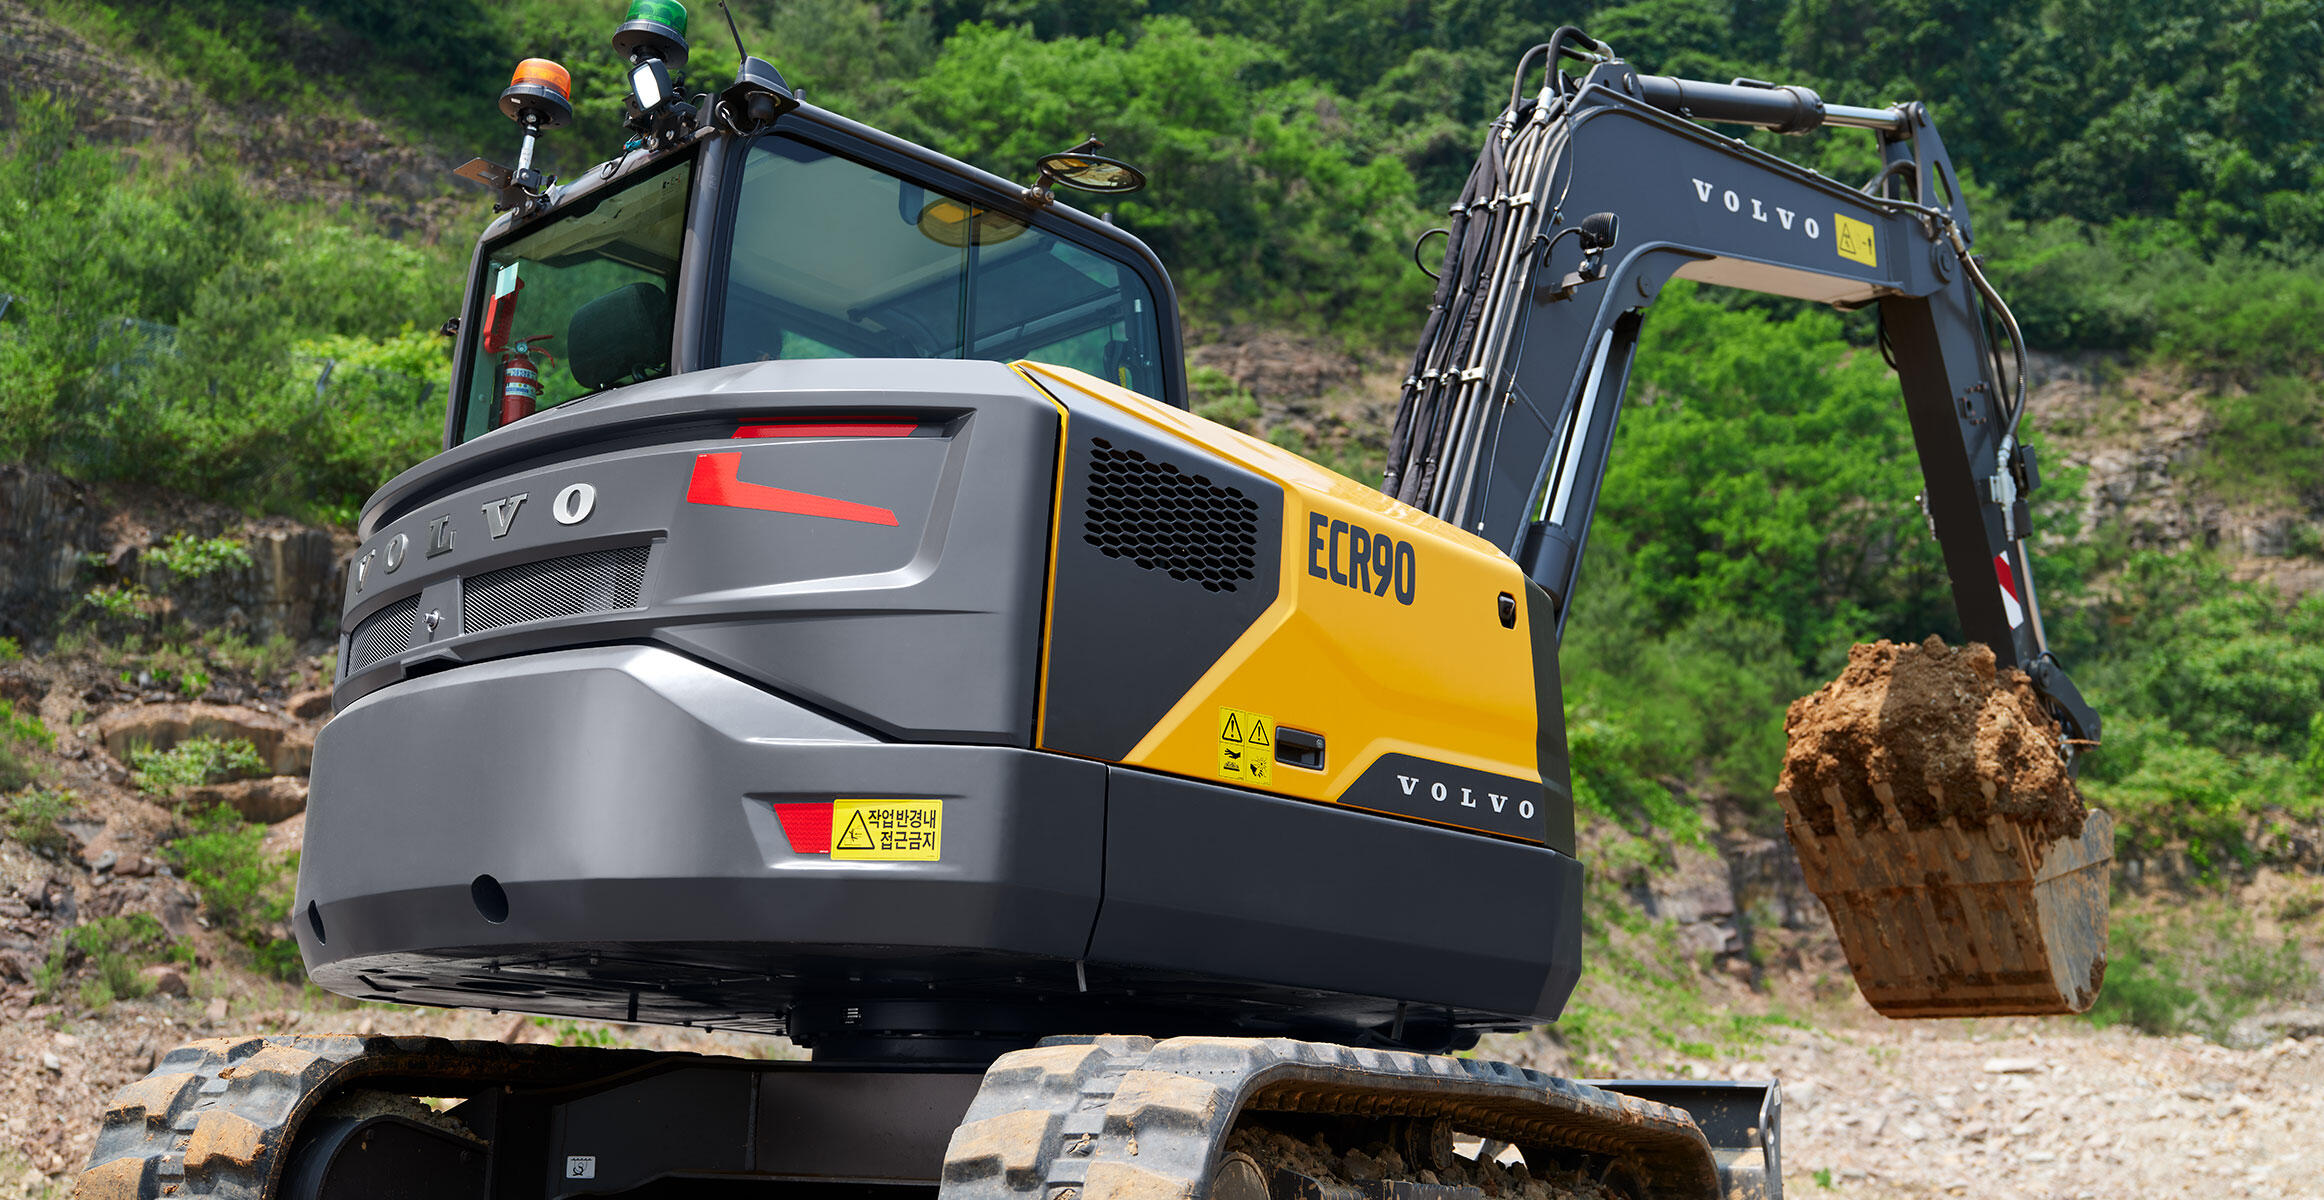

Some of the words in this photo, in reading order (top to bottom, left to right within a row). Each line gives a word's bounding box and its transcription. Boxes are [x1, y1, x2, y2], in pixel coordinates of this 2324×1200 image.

[1692, 178, 1820, 239] VOLVO
[355, 483, 597, 595] VOLVO
[1308, 511, 1416, 606] ECR90
[868, 809, 937, 829] 작업반경내
[1397, 775, 1535, 819] VOLVO
[880, 830, 936, 851] 접근금지
